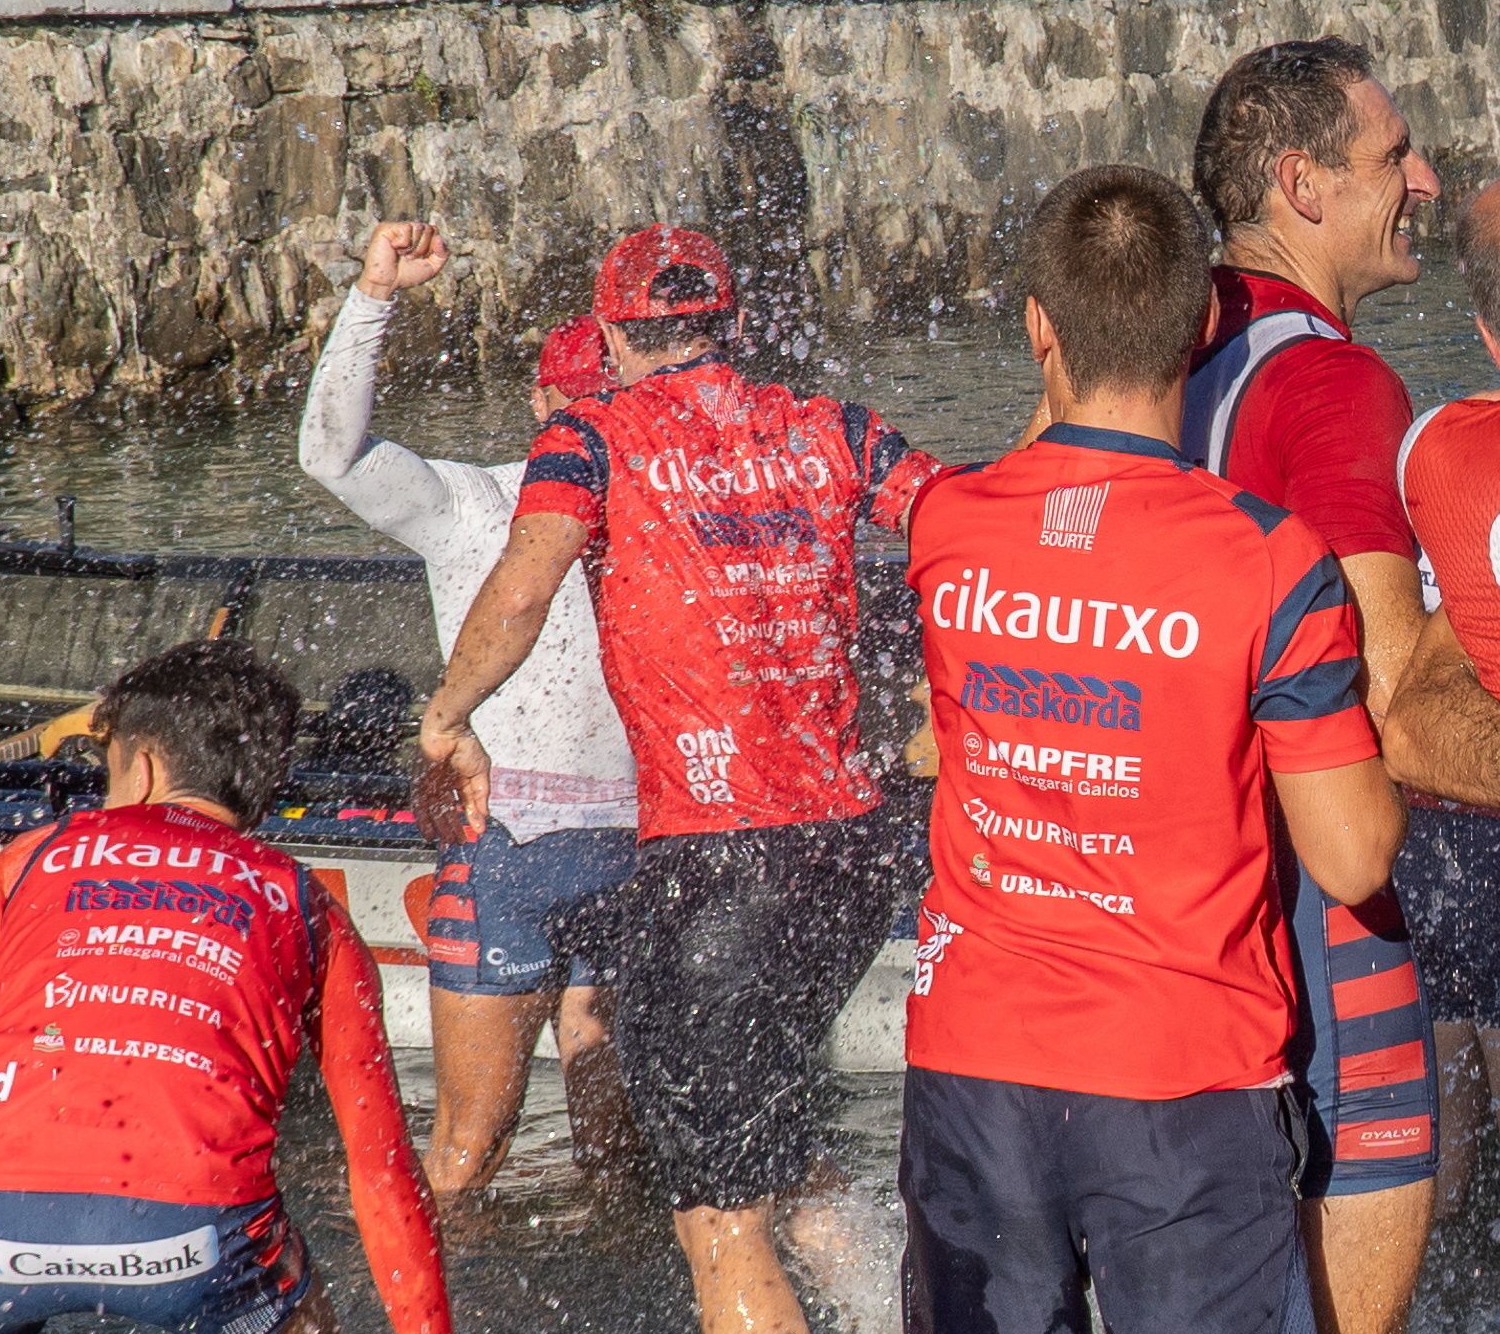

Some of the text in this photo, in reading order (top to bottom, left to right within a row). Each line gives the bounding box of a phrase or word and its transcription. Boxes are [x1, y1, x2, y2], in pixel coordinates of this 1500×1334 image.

[960, 672, 1142, 732] itsaskorda
[676, 724, 740, 758] ond
[987, 738, 1142, 782] MAPFRE
[685, 756, 731, 784] arr
[966, 758, 1008, 779] Idurre
[1078, 780, 1140, 799] Galdos
[689, 779, 736, 805] oa
[56, 944, 236, 986] Idurre Elezgarai Galdos
[86, 925, 243, 974] MAPFRE
[73, 1037, 214, 1073] URLAPESCA
[9, 1244, 204, 1278] CaixaBank
